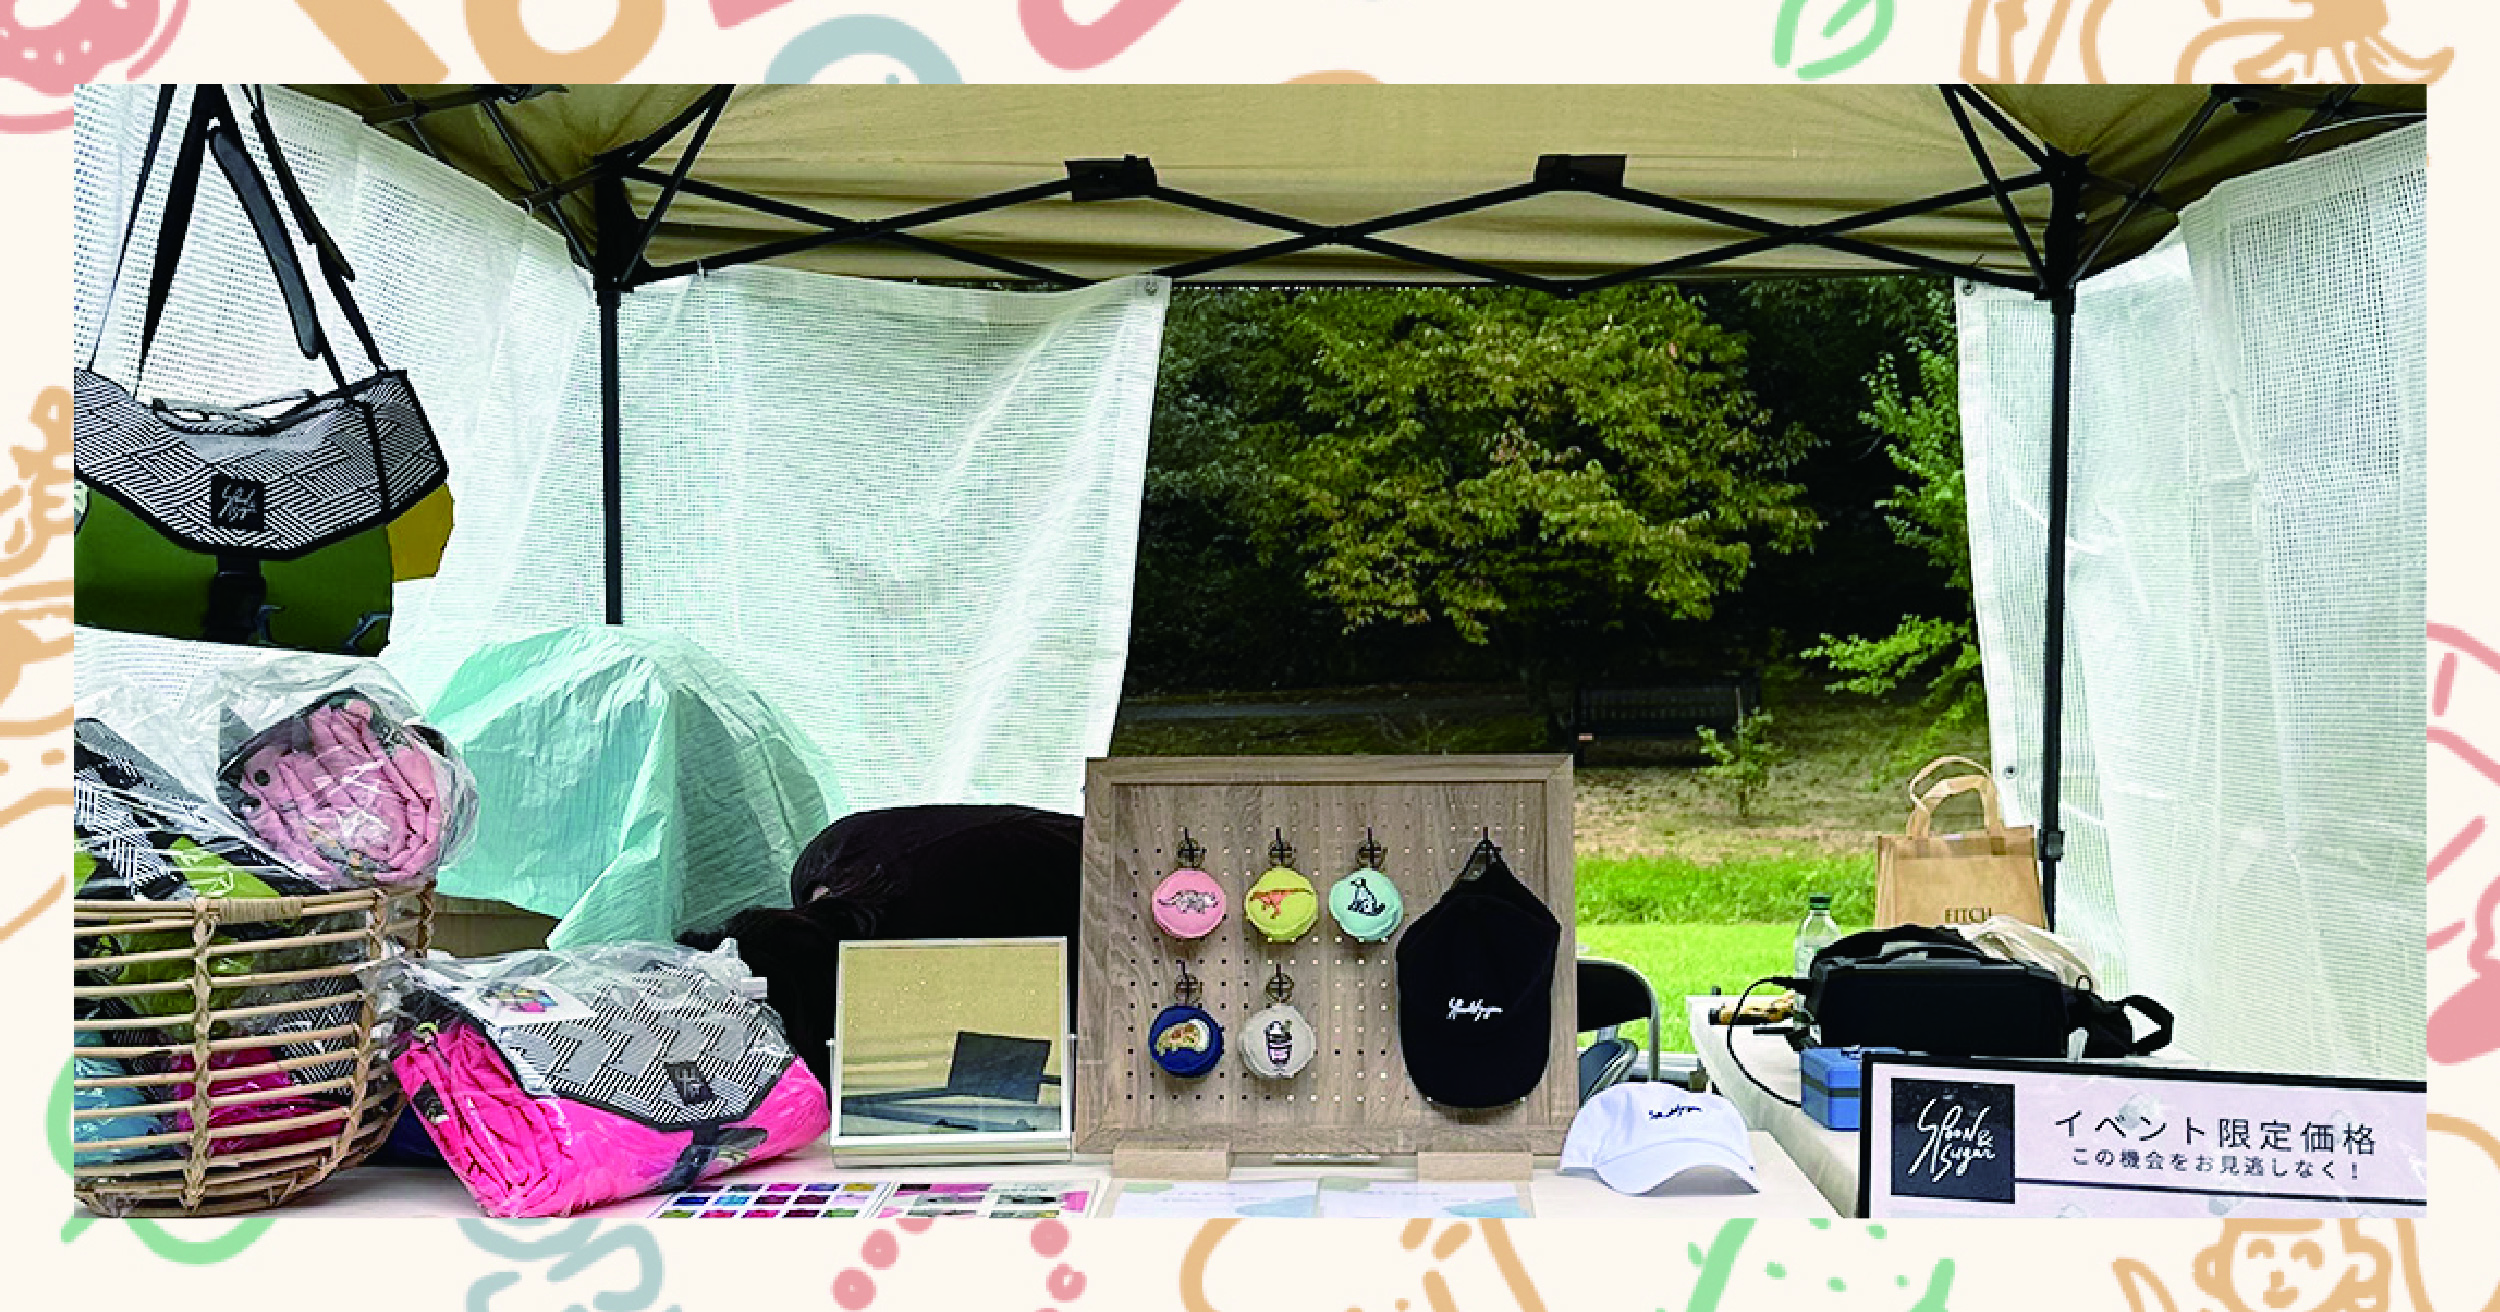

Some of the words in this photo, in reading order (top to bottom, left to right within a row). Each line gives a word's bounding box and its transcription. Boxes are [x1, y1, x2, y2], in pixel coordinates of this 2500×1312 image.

[2054, 1109, 2376, 1156] イベント限定価格
